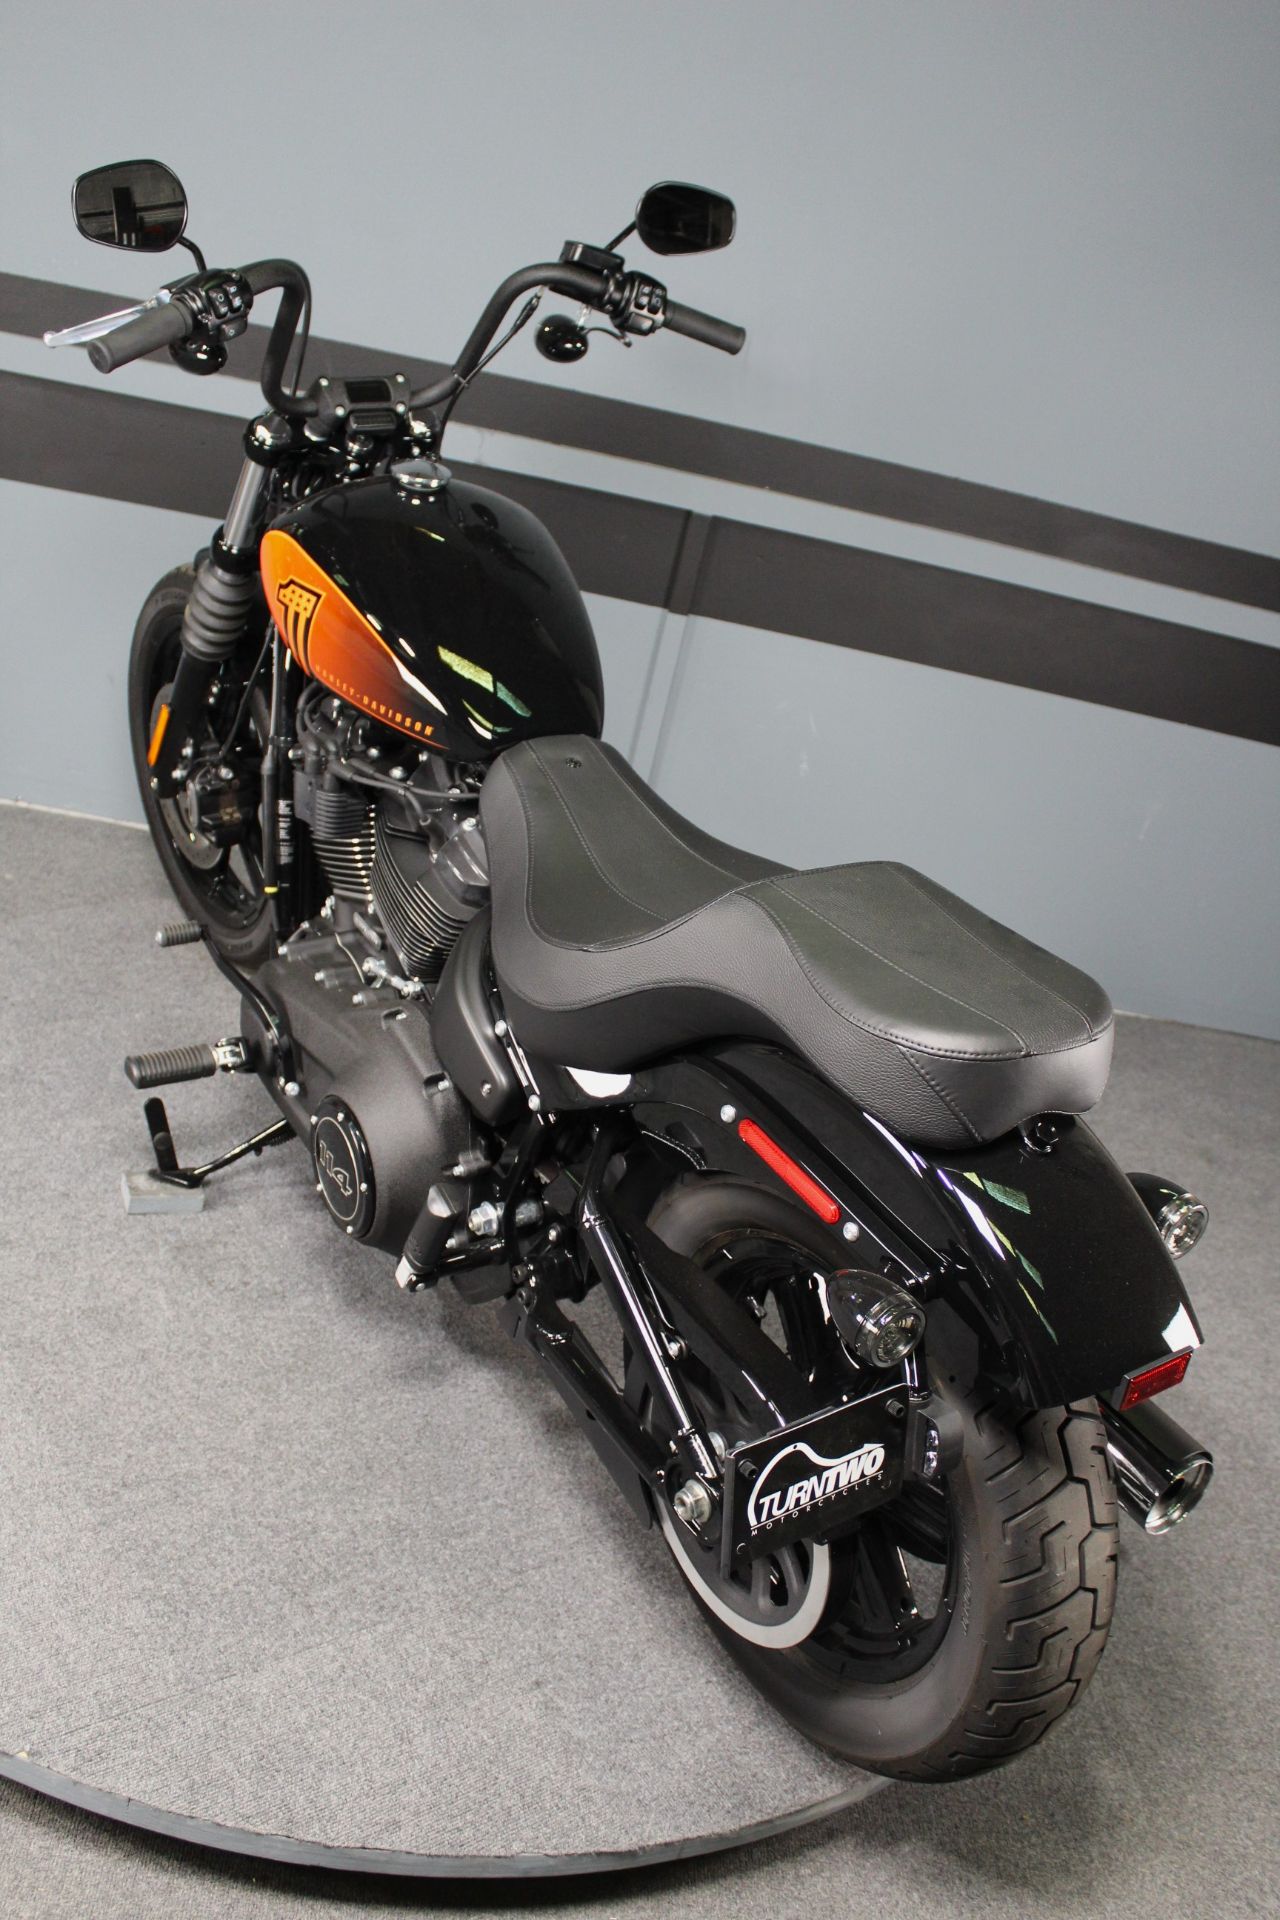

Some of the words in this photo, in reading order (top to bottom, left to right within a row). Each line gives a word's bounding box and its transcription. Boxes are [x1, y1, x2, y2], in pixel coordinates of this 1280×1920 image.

[315, 663, 434, 737] HARLEY-DAVIDSON
[319, 1140, 353, 1197] 114
[751, 1473, 882, 1536] MOTORCYCLES
